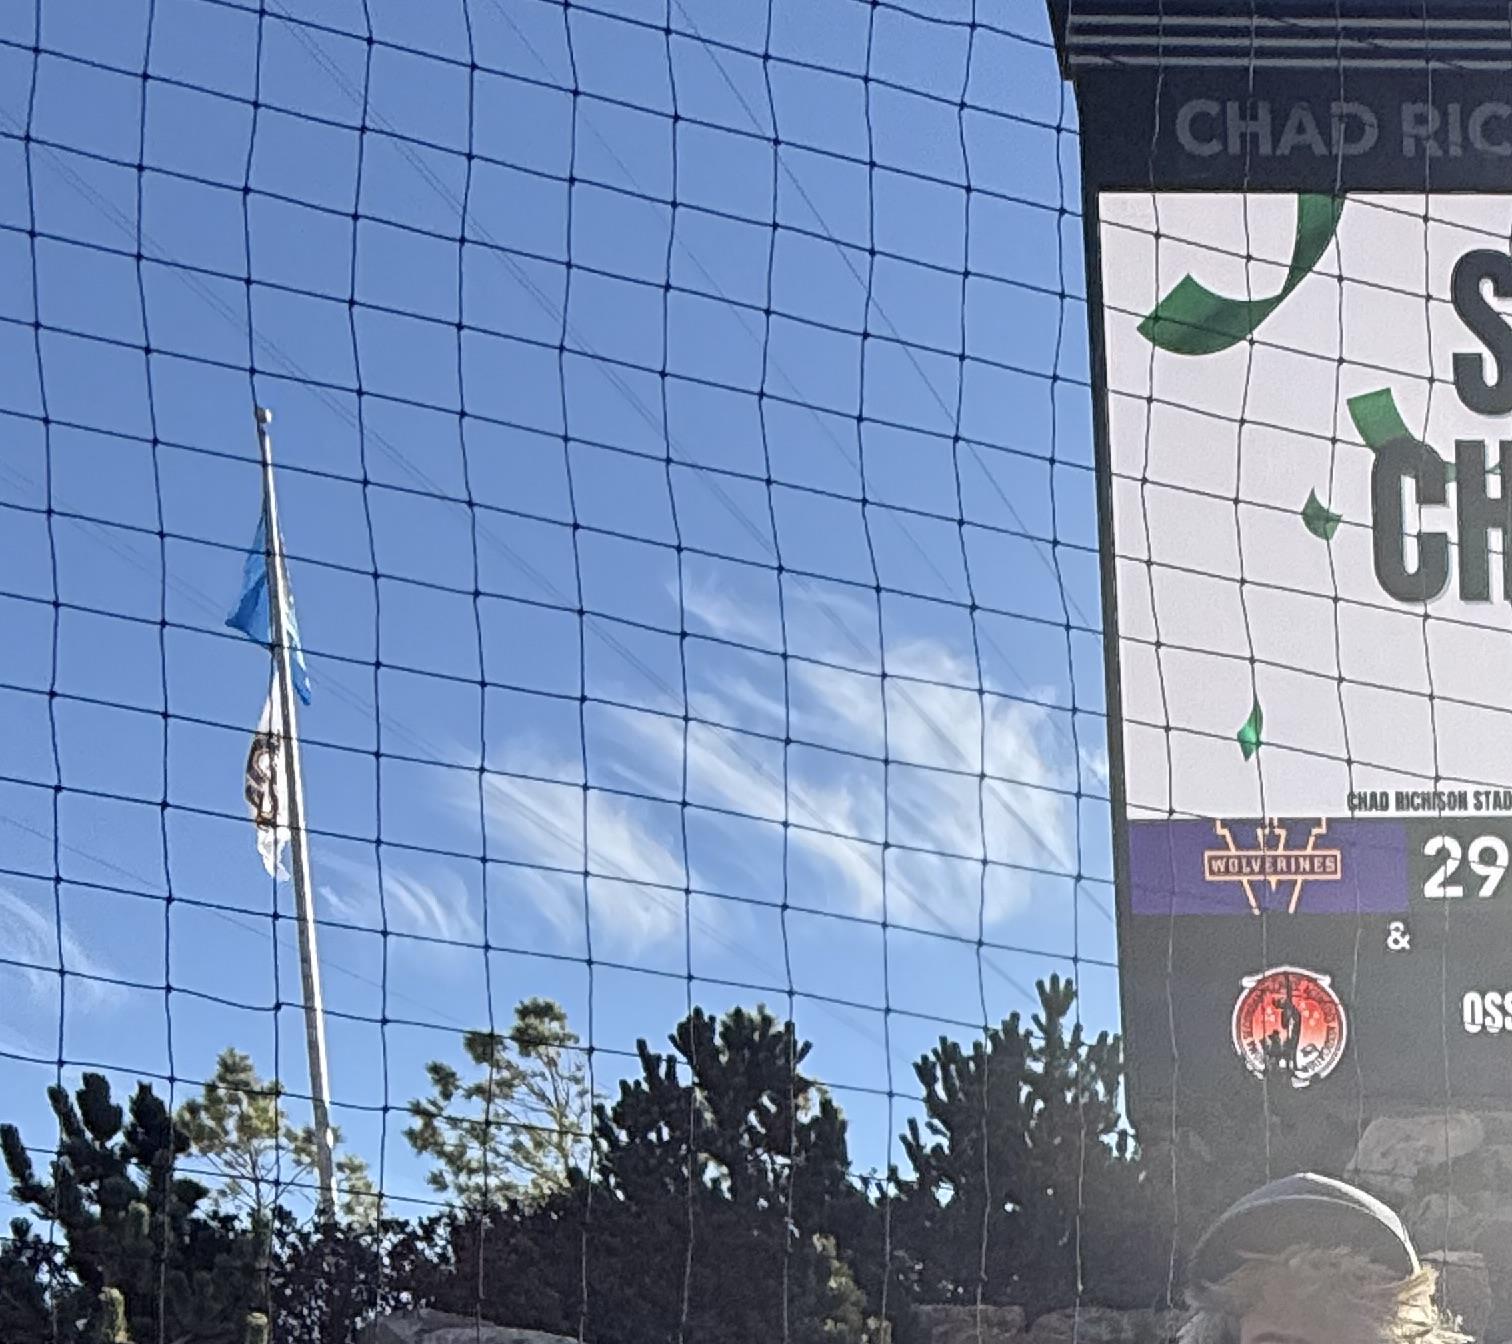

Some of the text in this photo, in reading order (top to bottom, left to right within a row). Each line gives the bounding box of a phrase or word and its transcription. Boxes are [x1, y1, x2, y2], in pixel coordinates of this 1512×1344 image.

[1174, 99, 1379, 157] CHAD
[1346, 790, 1390, 812] CHAD
[1395, 790, 1468, 812] RICHISON
[1210, 856, 1336, 874] WOLVERINES
[1423, 834, 1510, 898] 29
[1386, 920, 1411, 951] &
